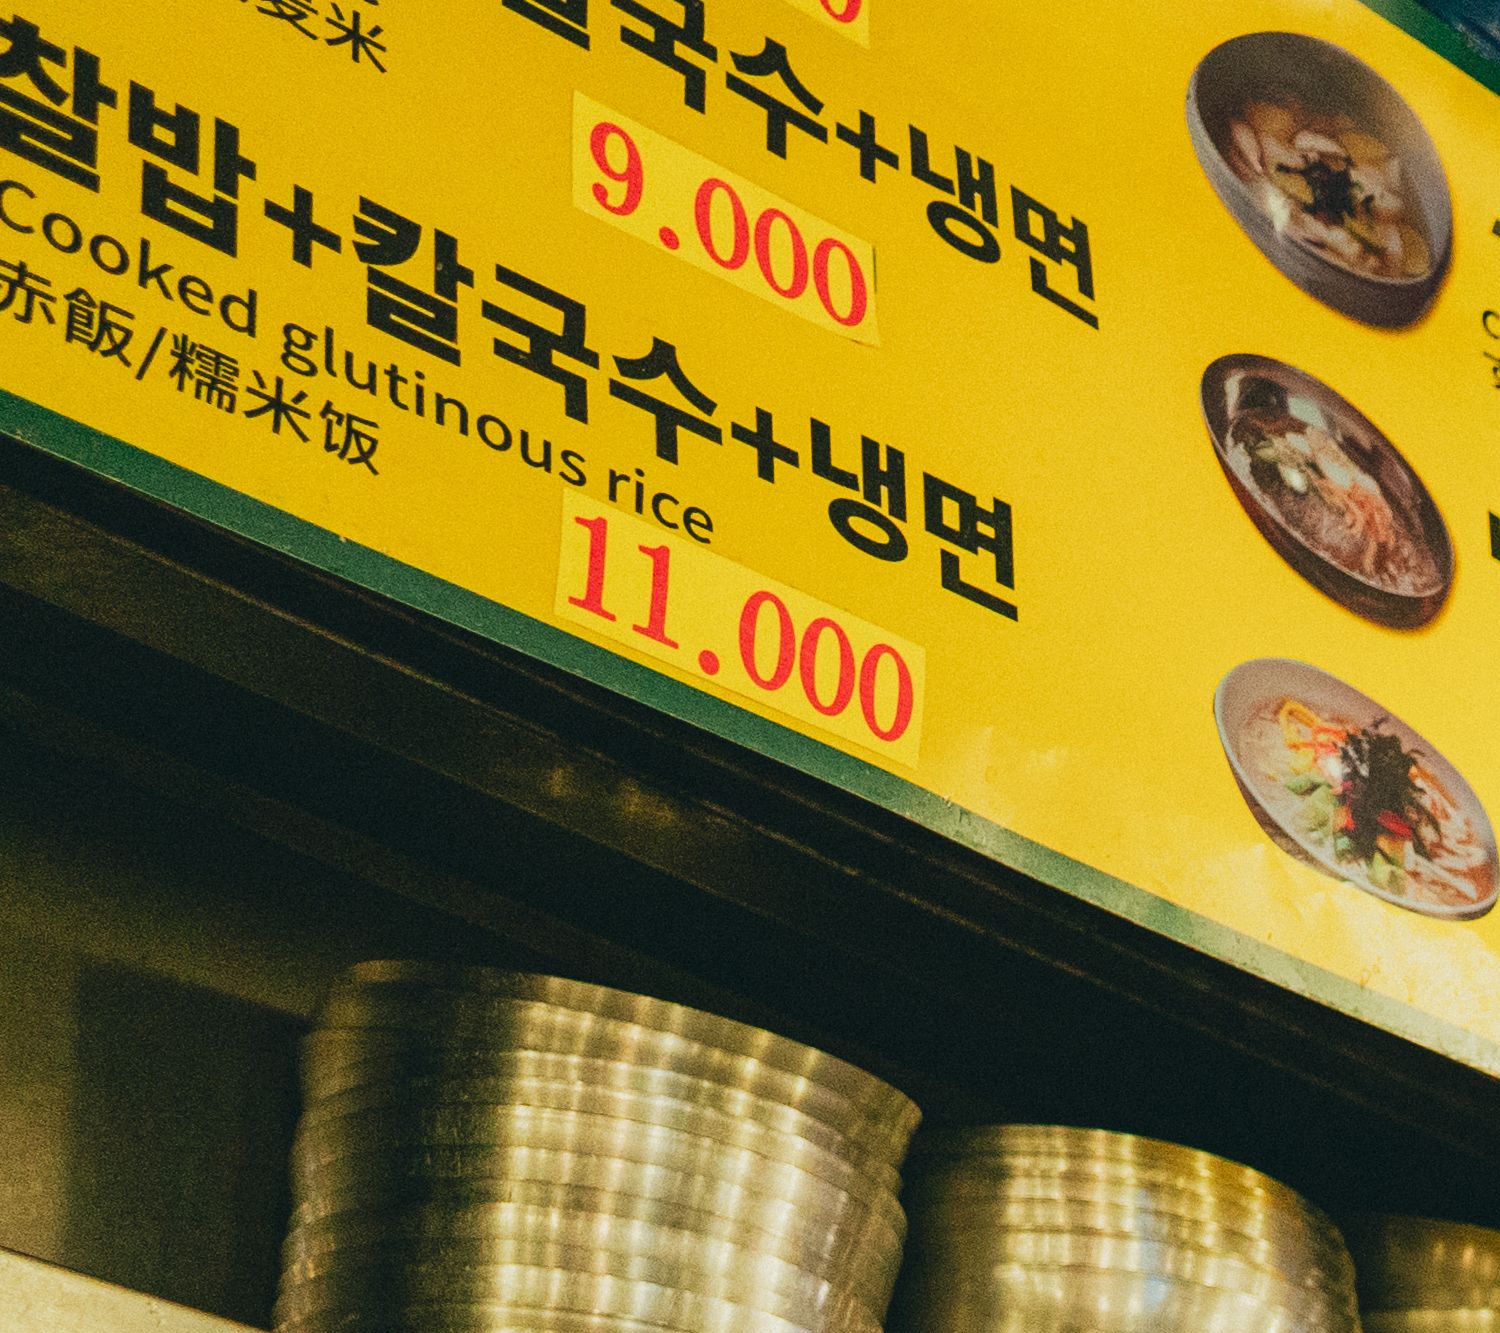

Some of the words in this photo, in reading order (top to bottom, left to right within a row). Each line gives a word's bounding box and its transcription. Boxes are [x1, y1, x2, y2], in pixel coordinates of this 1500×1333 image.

[0, 14, 1018, 621] 찰밥+칼국수+냉면
[0, 180, 257, 338] Cooked
[282, 322, 587, 486] glutinous
[607, 464, 715, 545] rice
[589, 121, 868, 327] 9.000
[567, 514, 914, 742] 11.000
